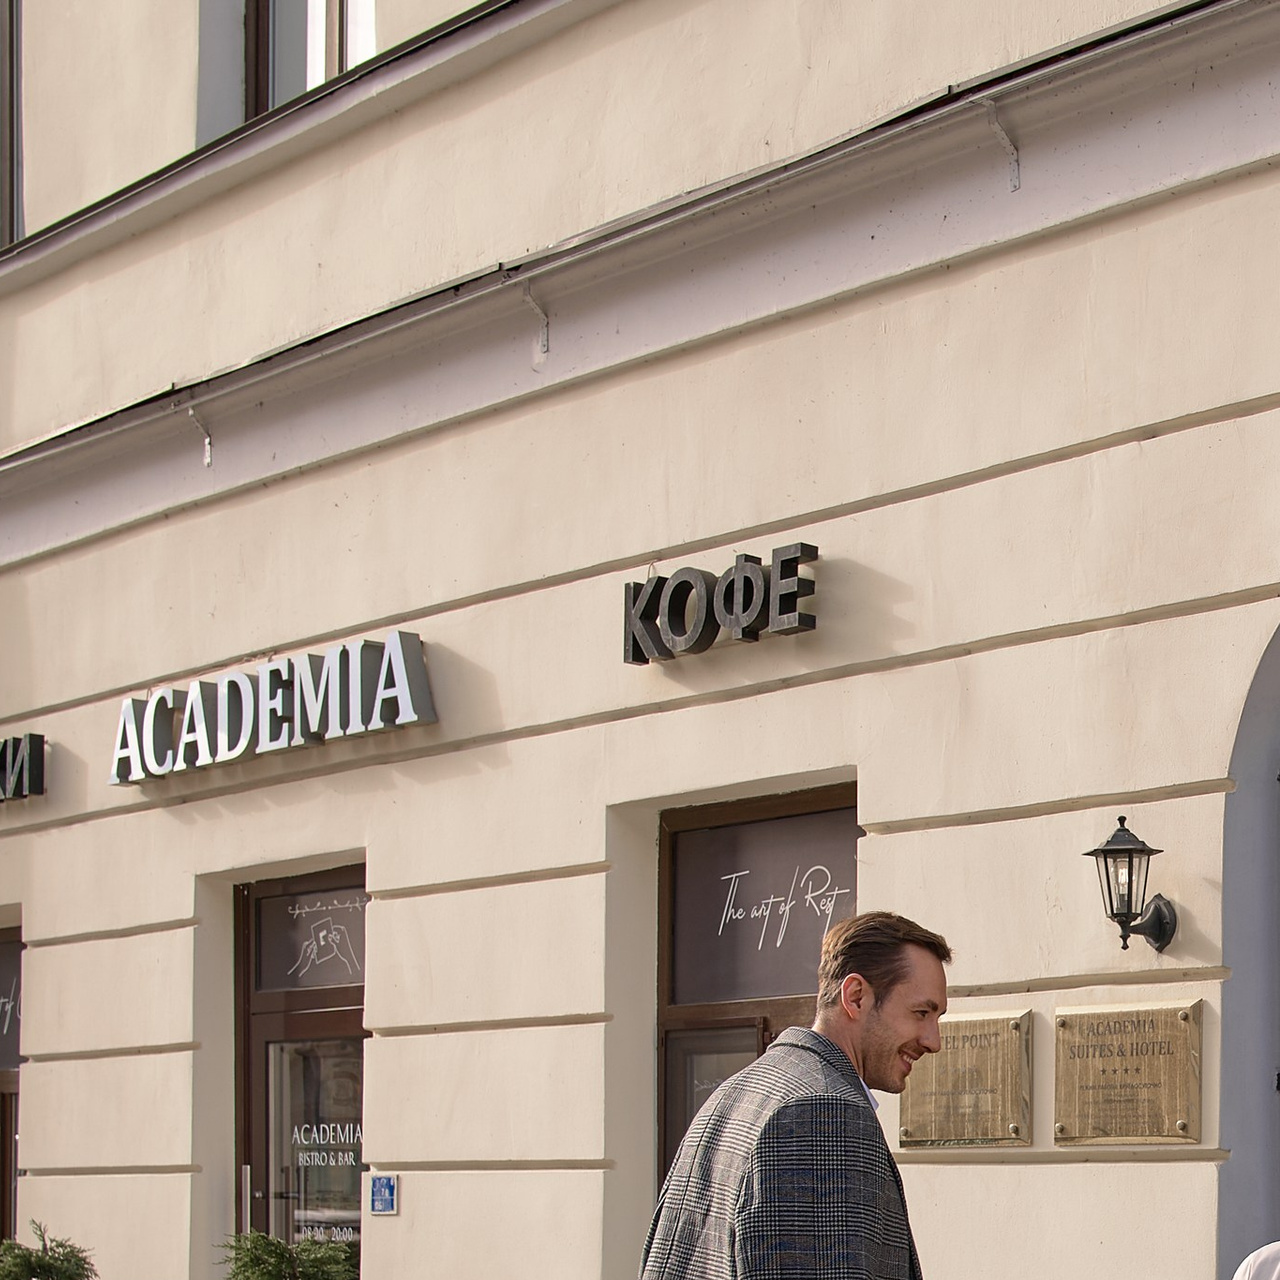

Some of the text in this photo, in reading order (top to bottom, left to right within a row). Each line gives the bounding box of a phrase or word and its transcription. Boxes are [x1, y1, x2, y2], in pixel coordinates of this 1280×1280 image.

[624, 542, 818, 666] КОФЕ
[108, 630, 432, 786] ACADEMIA
[718, 865, 850, 950] The art of Rest
[1087, 1018, 1155, 1037] ACADEMIA
[961, 1032, 1000, 1050] POINT
[1069, 1040, 1175, 1060] SUITES & HOTEL
[291, 1123, 363, 1145] ACADEMIA
[298, 1151, 356, 1166] BISTRO & BAR
[331, 1226, 353, 1241] 20:00
